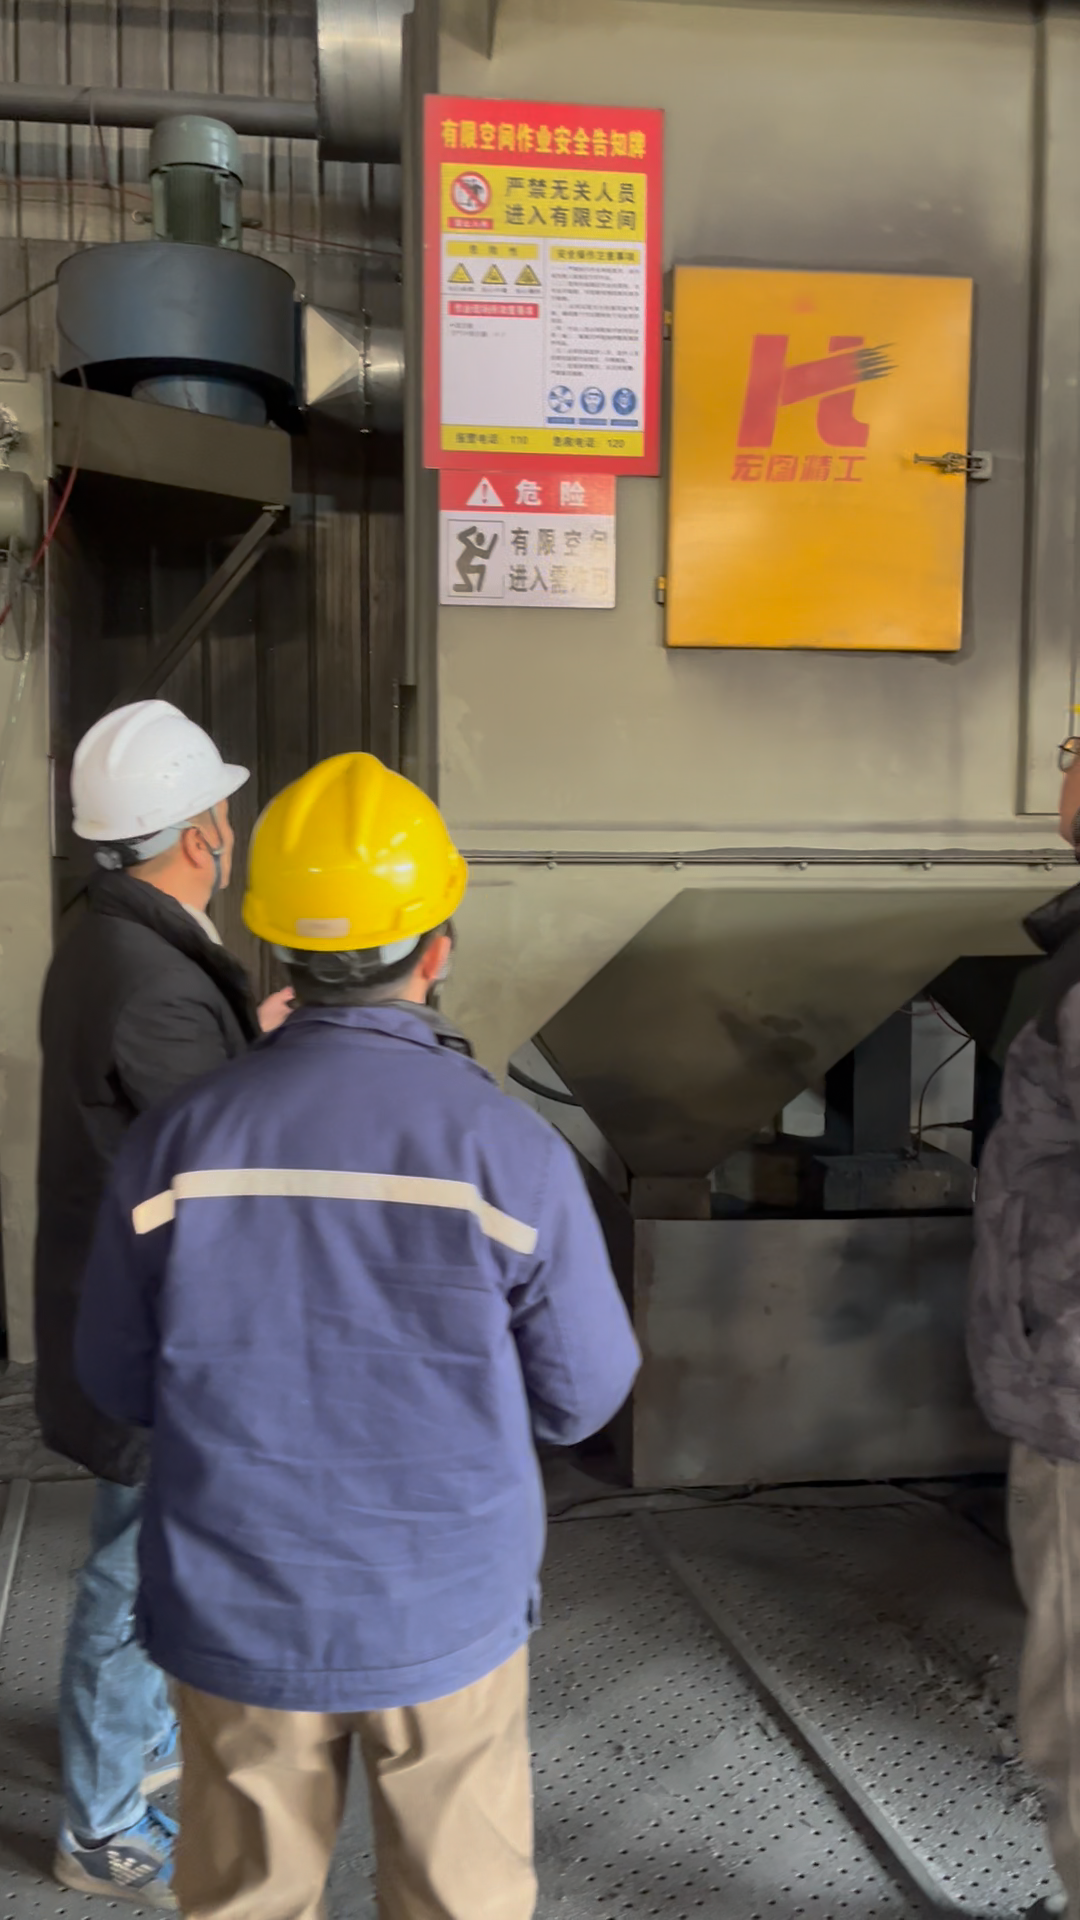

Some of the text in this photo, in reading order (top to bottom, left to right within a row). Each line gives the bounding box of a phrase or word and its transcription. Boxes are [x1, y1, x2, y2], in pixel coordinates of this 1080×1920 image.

[441, 119, 646, 159] 有限空间作业安全告知牌
[505, 176, 635, 204] 严禁无关人员
[505, 204, 636, 231] 进入有限空间
[608, 438, 625, 449] 120
[515, 479, 587, 507] 危险
